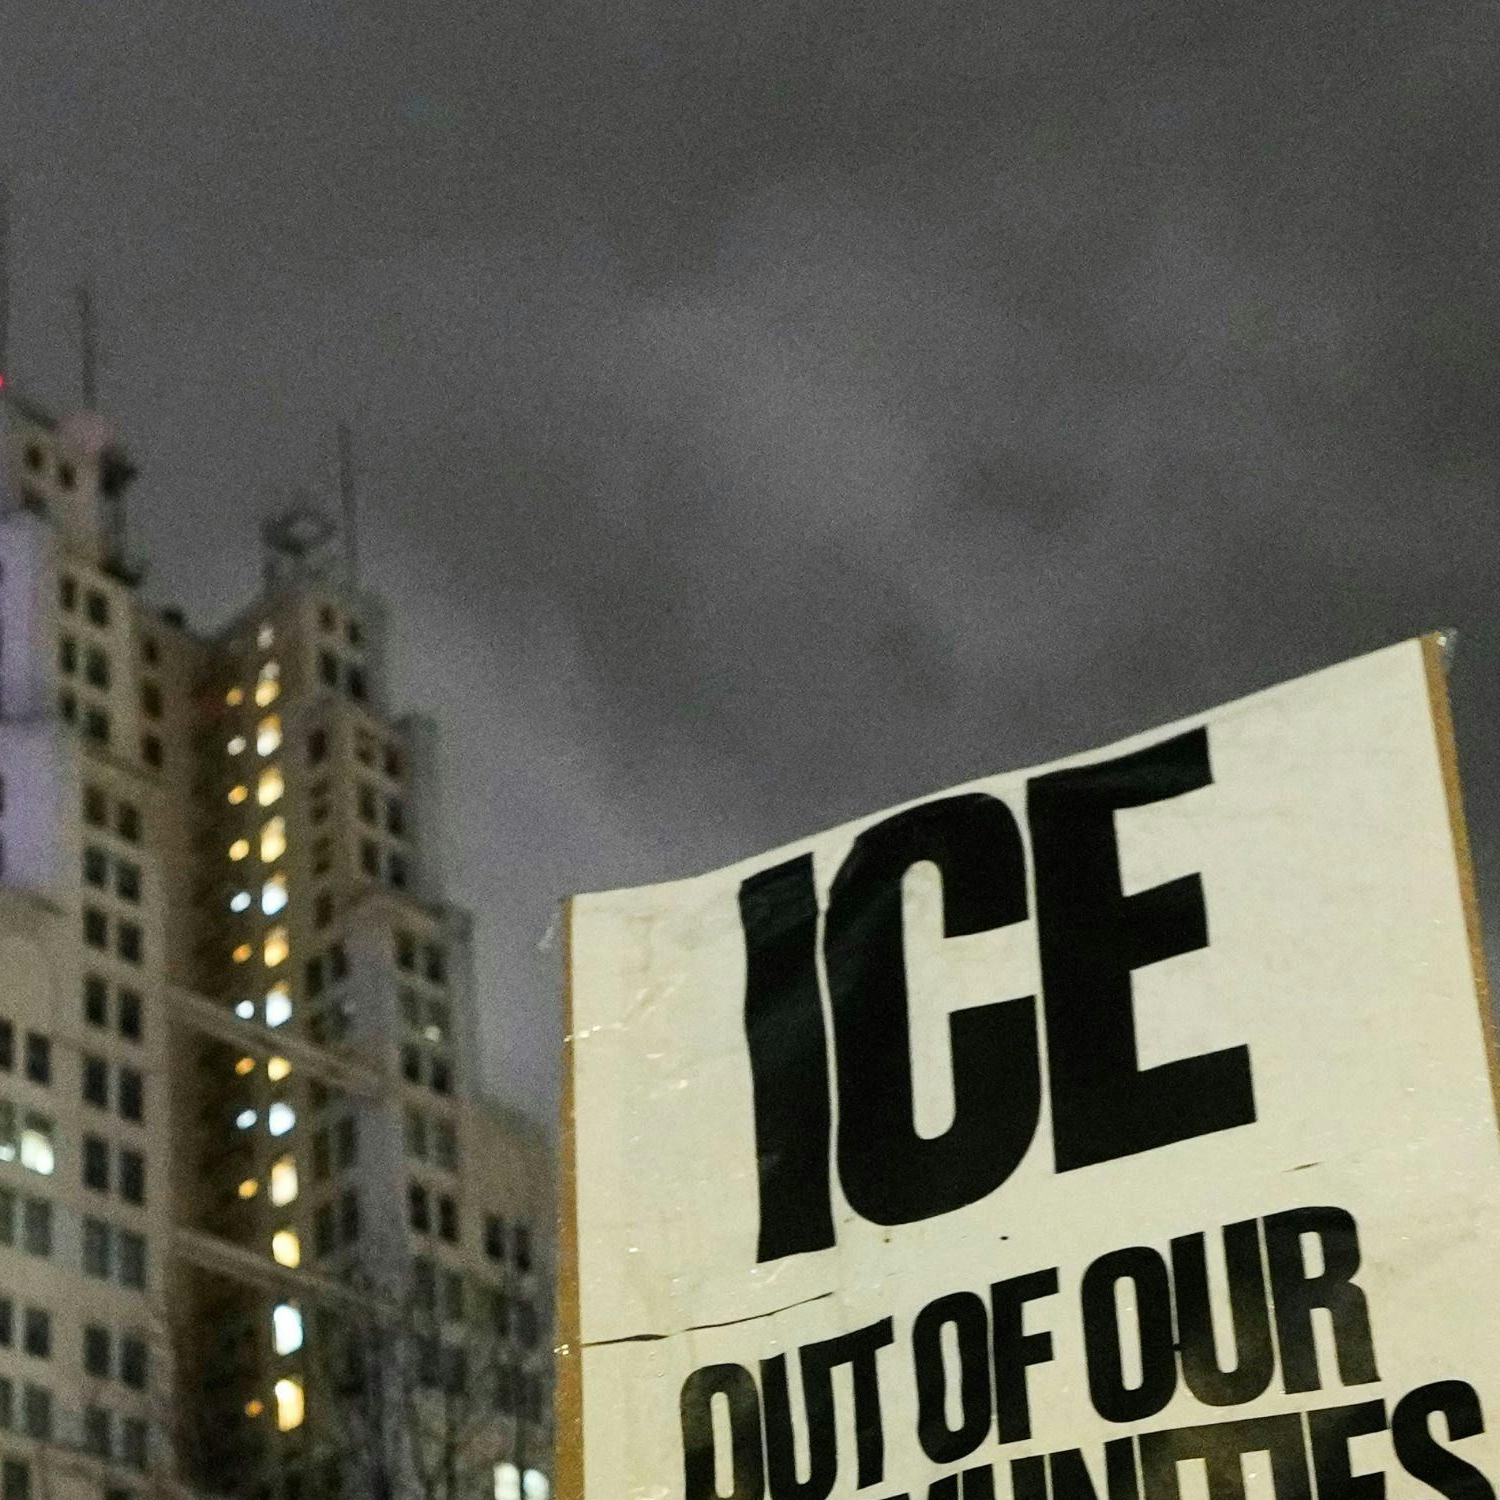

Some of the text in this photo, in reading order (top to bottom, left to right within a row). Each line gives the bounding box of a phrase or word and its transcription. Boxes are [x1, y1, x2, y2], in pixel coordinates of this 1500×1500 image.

[738, 725, 1257, 1263] ICE
[912, 1267, 1059, 1464] OF
[1080, 1205, 1380, 1423] OUR
